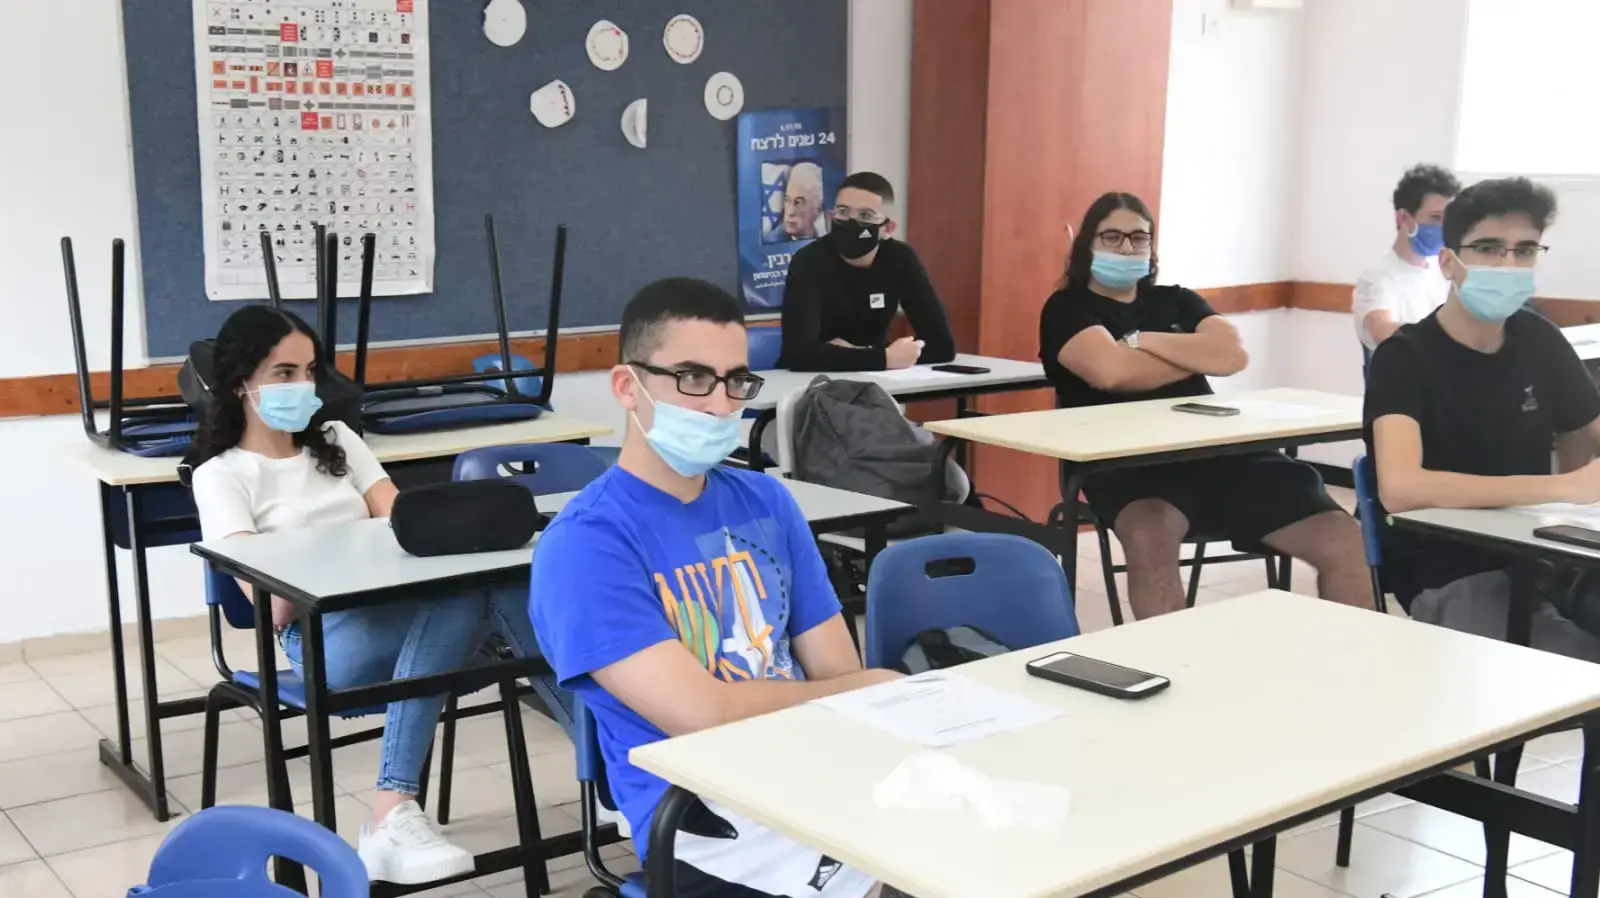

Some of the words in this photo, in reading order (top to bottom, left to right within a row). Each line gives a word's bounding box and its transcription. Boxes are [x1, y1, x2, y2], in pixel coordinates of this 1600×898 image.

[751, 133, 785, 151] לרצח
[787, 133, 815, 147] שנים
[818, 131, 836, 145] 24
